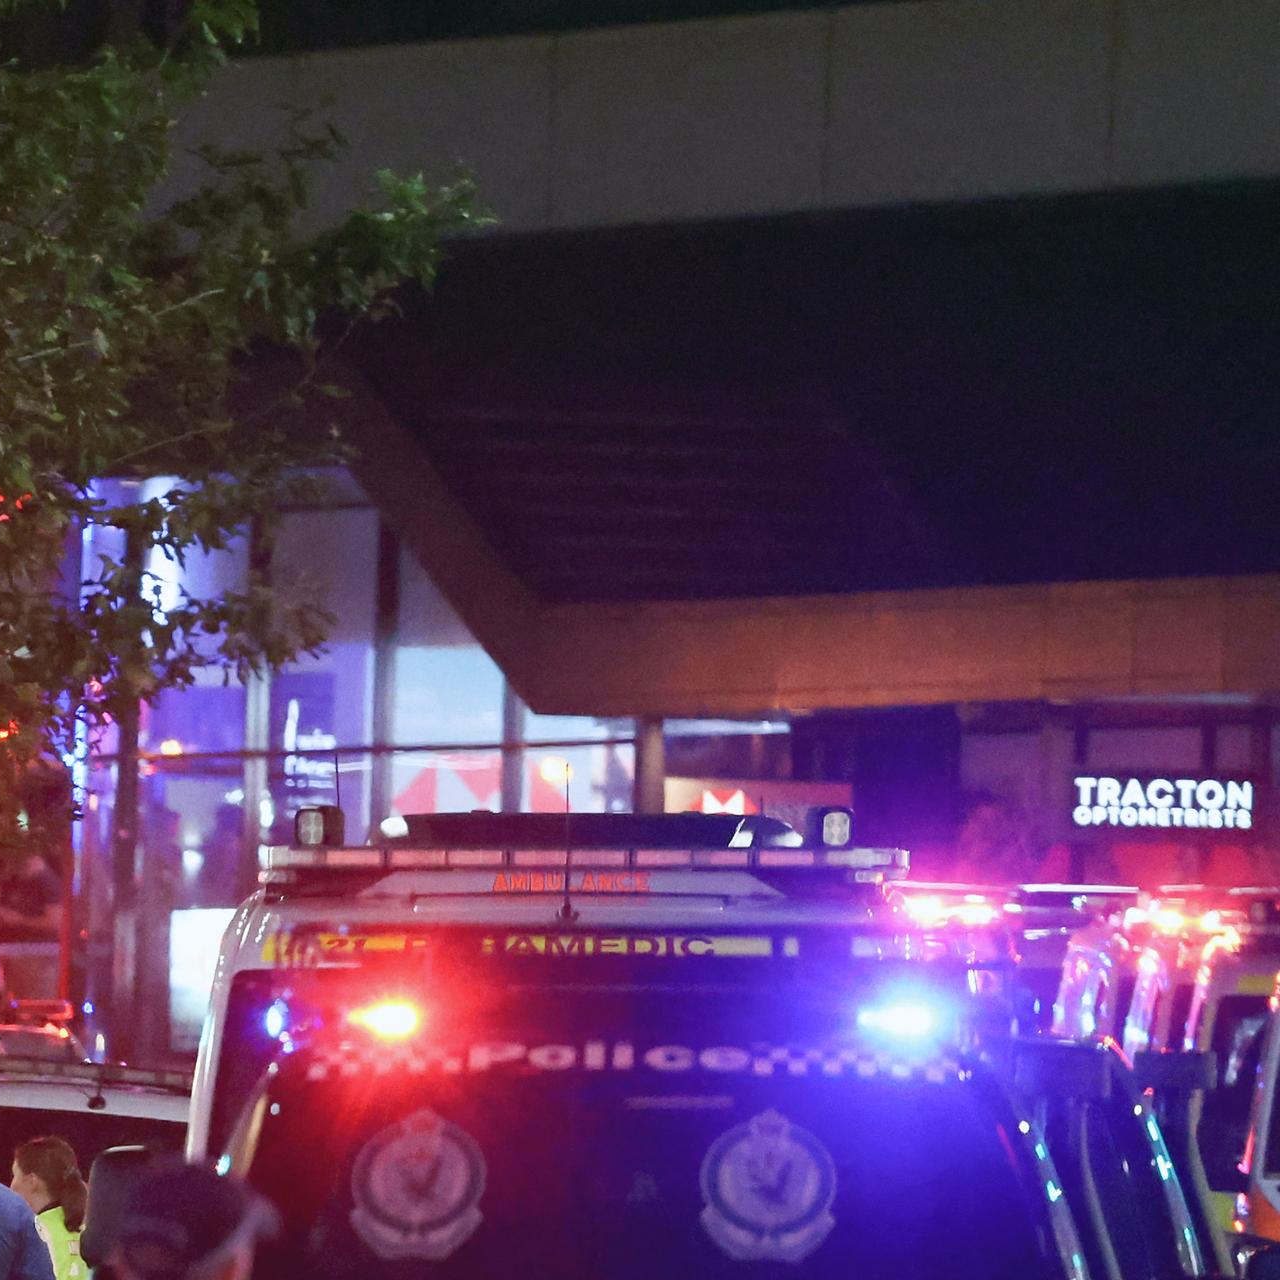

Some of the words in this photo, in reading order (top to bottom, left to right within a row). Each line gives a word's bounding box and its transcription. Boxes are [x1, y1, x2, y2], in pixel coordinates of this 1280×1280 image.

[1073, 777, 1253, 810] TRACTON
[1072, 805, 1252, 829] OPTOMETRISTS
[406, 935, 716, 957] PAMEDIC
[468, 1040, 752, 1071] Police
